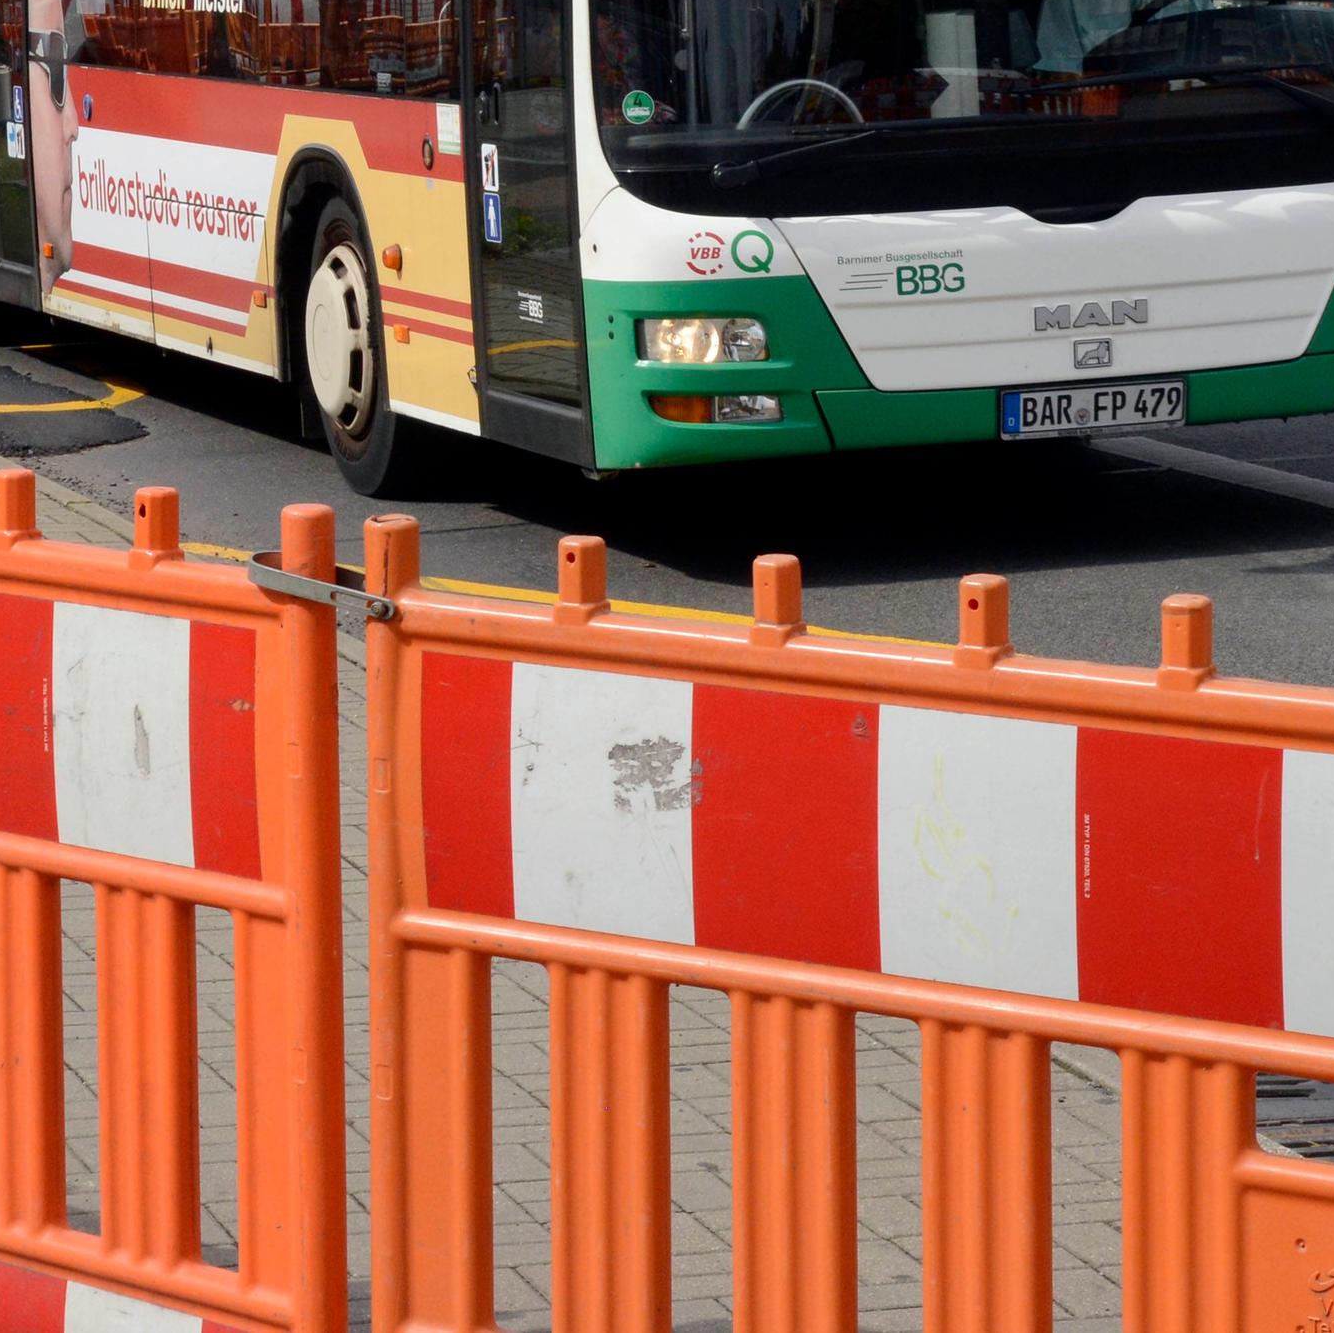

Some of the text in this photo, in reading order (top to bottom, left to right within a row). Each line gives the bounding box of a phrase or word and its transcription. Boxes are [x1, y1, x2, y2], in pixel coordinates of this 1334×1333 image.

[633, 93, 642, 107] 4
[77, 155, 258, 243] brillenstudio reusner
[690, 246, 721, 261] VBB
[837, 249, 963, 266] Barnimer Busgesellschaft
[895, 261, 966, 296] BBG
[1034, 299, 1148, 331] MAN
[1022, 386, 1181, 427] BAR FP 479
